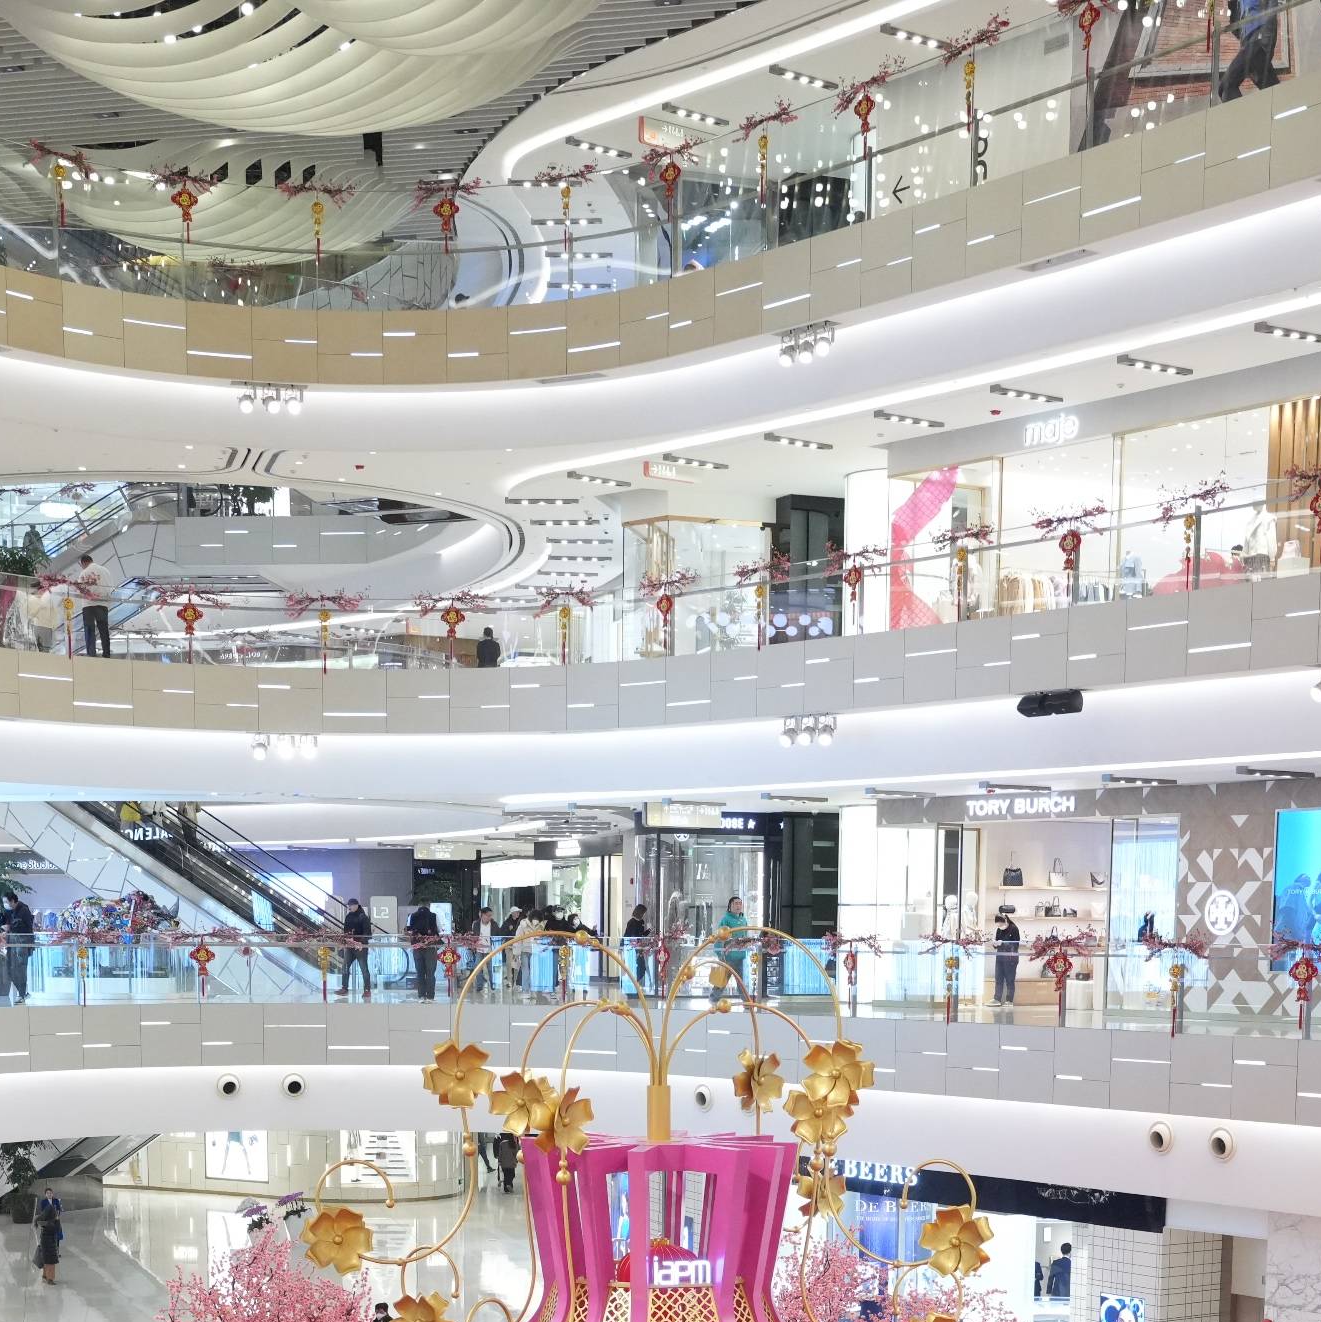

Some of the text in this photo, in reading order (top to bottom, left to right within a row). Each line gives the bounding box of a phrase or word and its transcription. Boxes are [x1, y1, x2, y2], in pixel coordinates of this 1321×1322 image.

[1024, 413, 1079, 446] maje
[966, 796, 1075, 816] TORY BURCH
[373, 907, 389, 919] L2
[844, 1159, 918, 1187] BEERS
